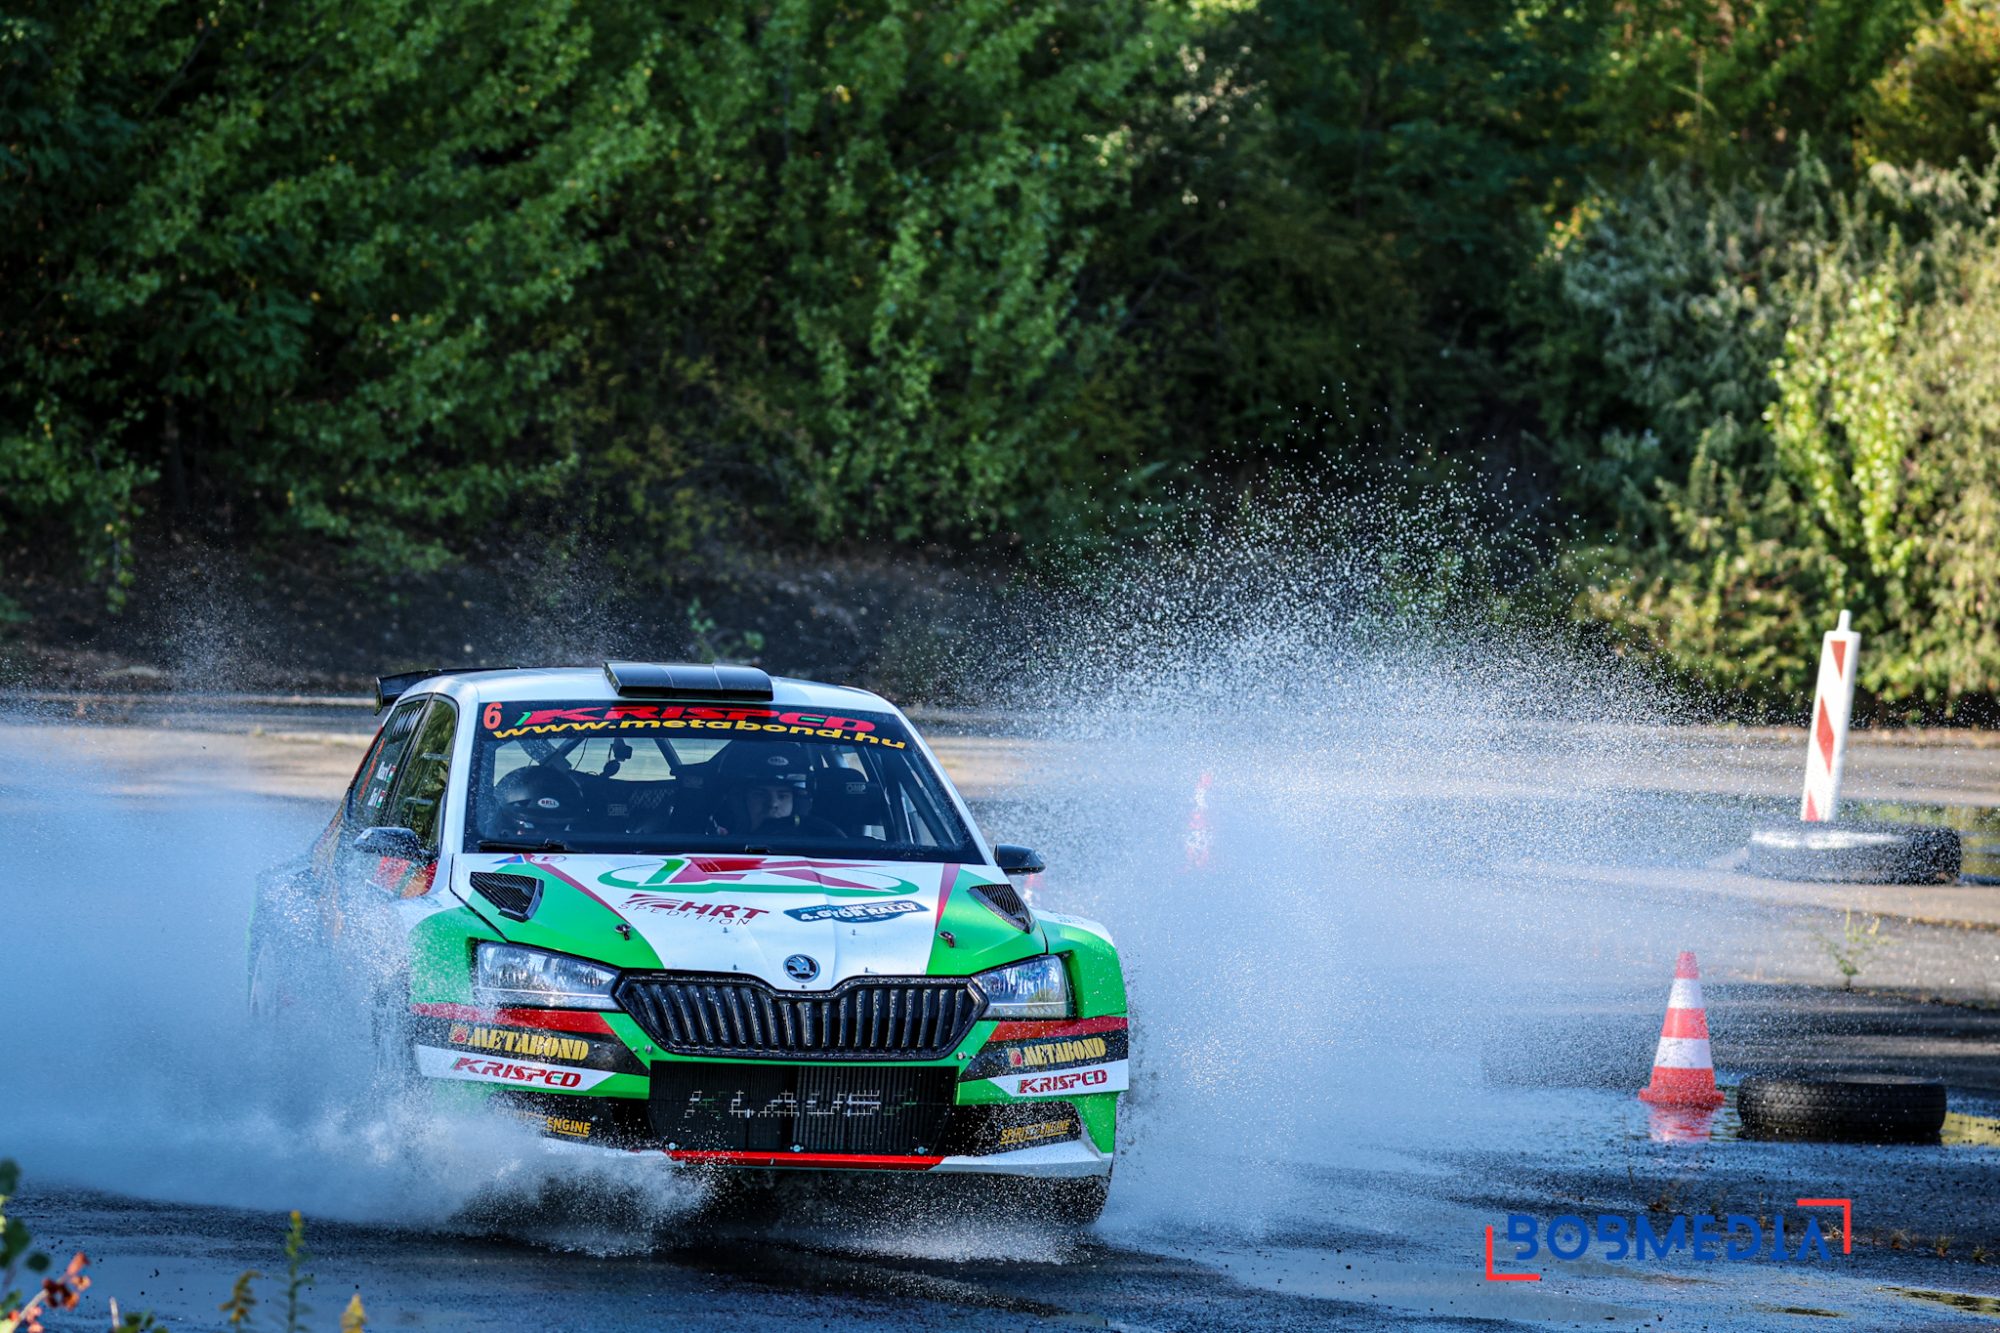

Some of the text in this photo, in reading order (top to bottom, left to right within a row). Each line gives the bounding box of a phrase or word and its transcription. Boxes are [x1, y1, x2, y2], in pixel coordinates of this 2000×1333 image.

[483, 702, 502, 729] 6
[515, 706, 876, 732] KRISPED
[493, 719, 906, 749] www.metabond.hu
[618, 903, 751, 926] SPEDITION
[678, 901, 771, 919] HRT
[866, 902, 917, 916] RALLY
[466, 1027, 590, 1061] METABOND
[1024, 1037, 1107, 1067] METABOND
[450, 1057, 582, 1088] KRISPED
[1018, 1069, 1108, 1094] KRISPED
[546, 1116, 592, 1136] ENGINE
